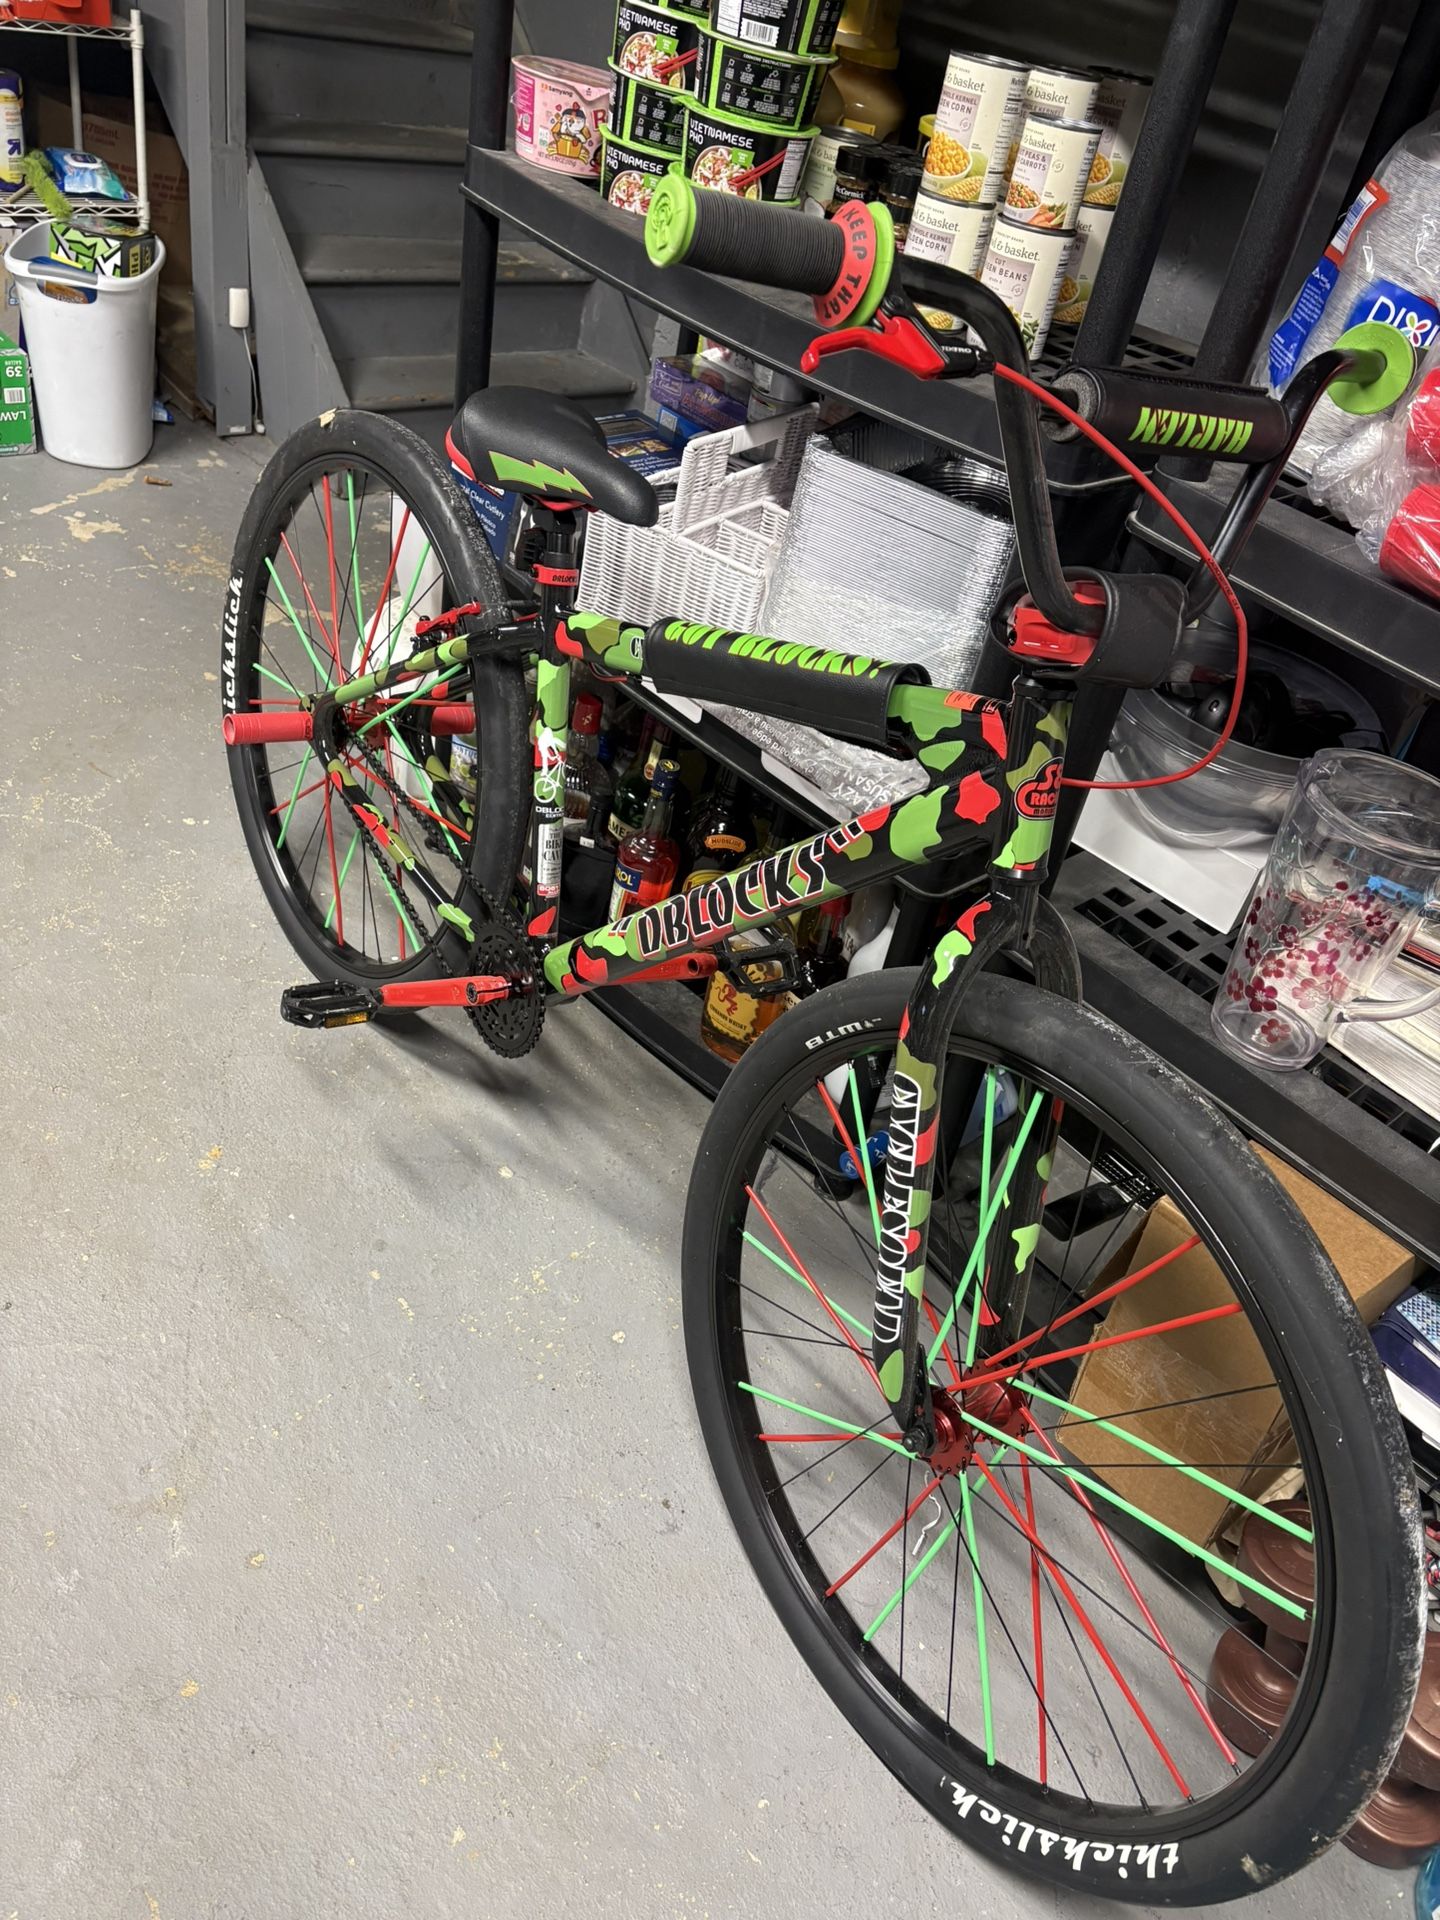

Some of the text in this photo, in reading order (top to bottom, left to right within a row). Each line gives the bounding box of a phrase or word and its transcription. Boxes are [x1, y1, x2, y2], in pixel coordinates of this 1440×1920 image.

[619, 18, 630, 31] PHO
[620, 7, 678, 36] VIETNAMESE
[548, 85, 573, 97] Samyang
[951, 100, 972, 114] CORN
[955, 93, 977, 106] KERNEL
[689, 130, 703, 144] PHO
[690, 118, 753, 149] VIETNAMESE
[606, 156, 618, 169] PHO
[607, 145, 663, 174] VIETNAMESE
[1025, 150, 1041, 162] PEAS
[926, 213, 960, 232] basket.
[929, 231, 952, 244] KERNEL
[925, 240, 947, 252] CORN
[996, 240, 1040, 261] & basket.
[824, 208, 867, 320] KEEP THAT
[999, 269, 1028, 282] BEANS
[1366, 295, 1440, 347] DIXI
[5, 366, 23, 378] 39
[0, 410, 27, 421] LAW
[664, 620, 733, 650] GOT
[223, 576, 243, 714] ickslick
[752, 728, 772, 744] edge
[760, 721, 789, 743] tableau
[771, 742, 815, 773] chlkboard
[844, 769, 891, 802] SUSAN
[833, 782, 873, 812] LAZY
[1030, 792, 1056, 806] RAC
[535, 806, 564, 814] DBLOC
[545, 840, 561, 850] BIK
[805, 1022, 863, 1050] WTB
